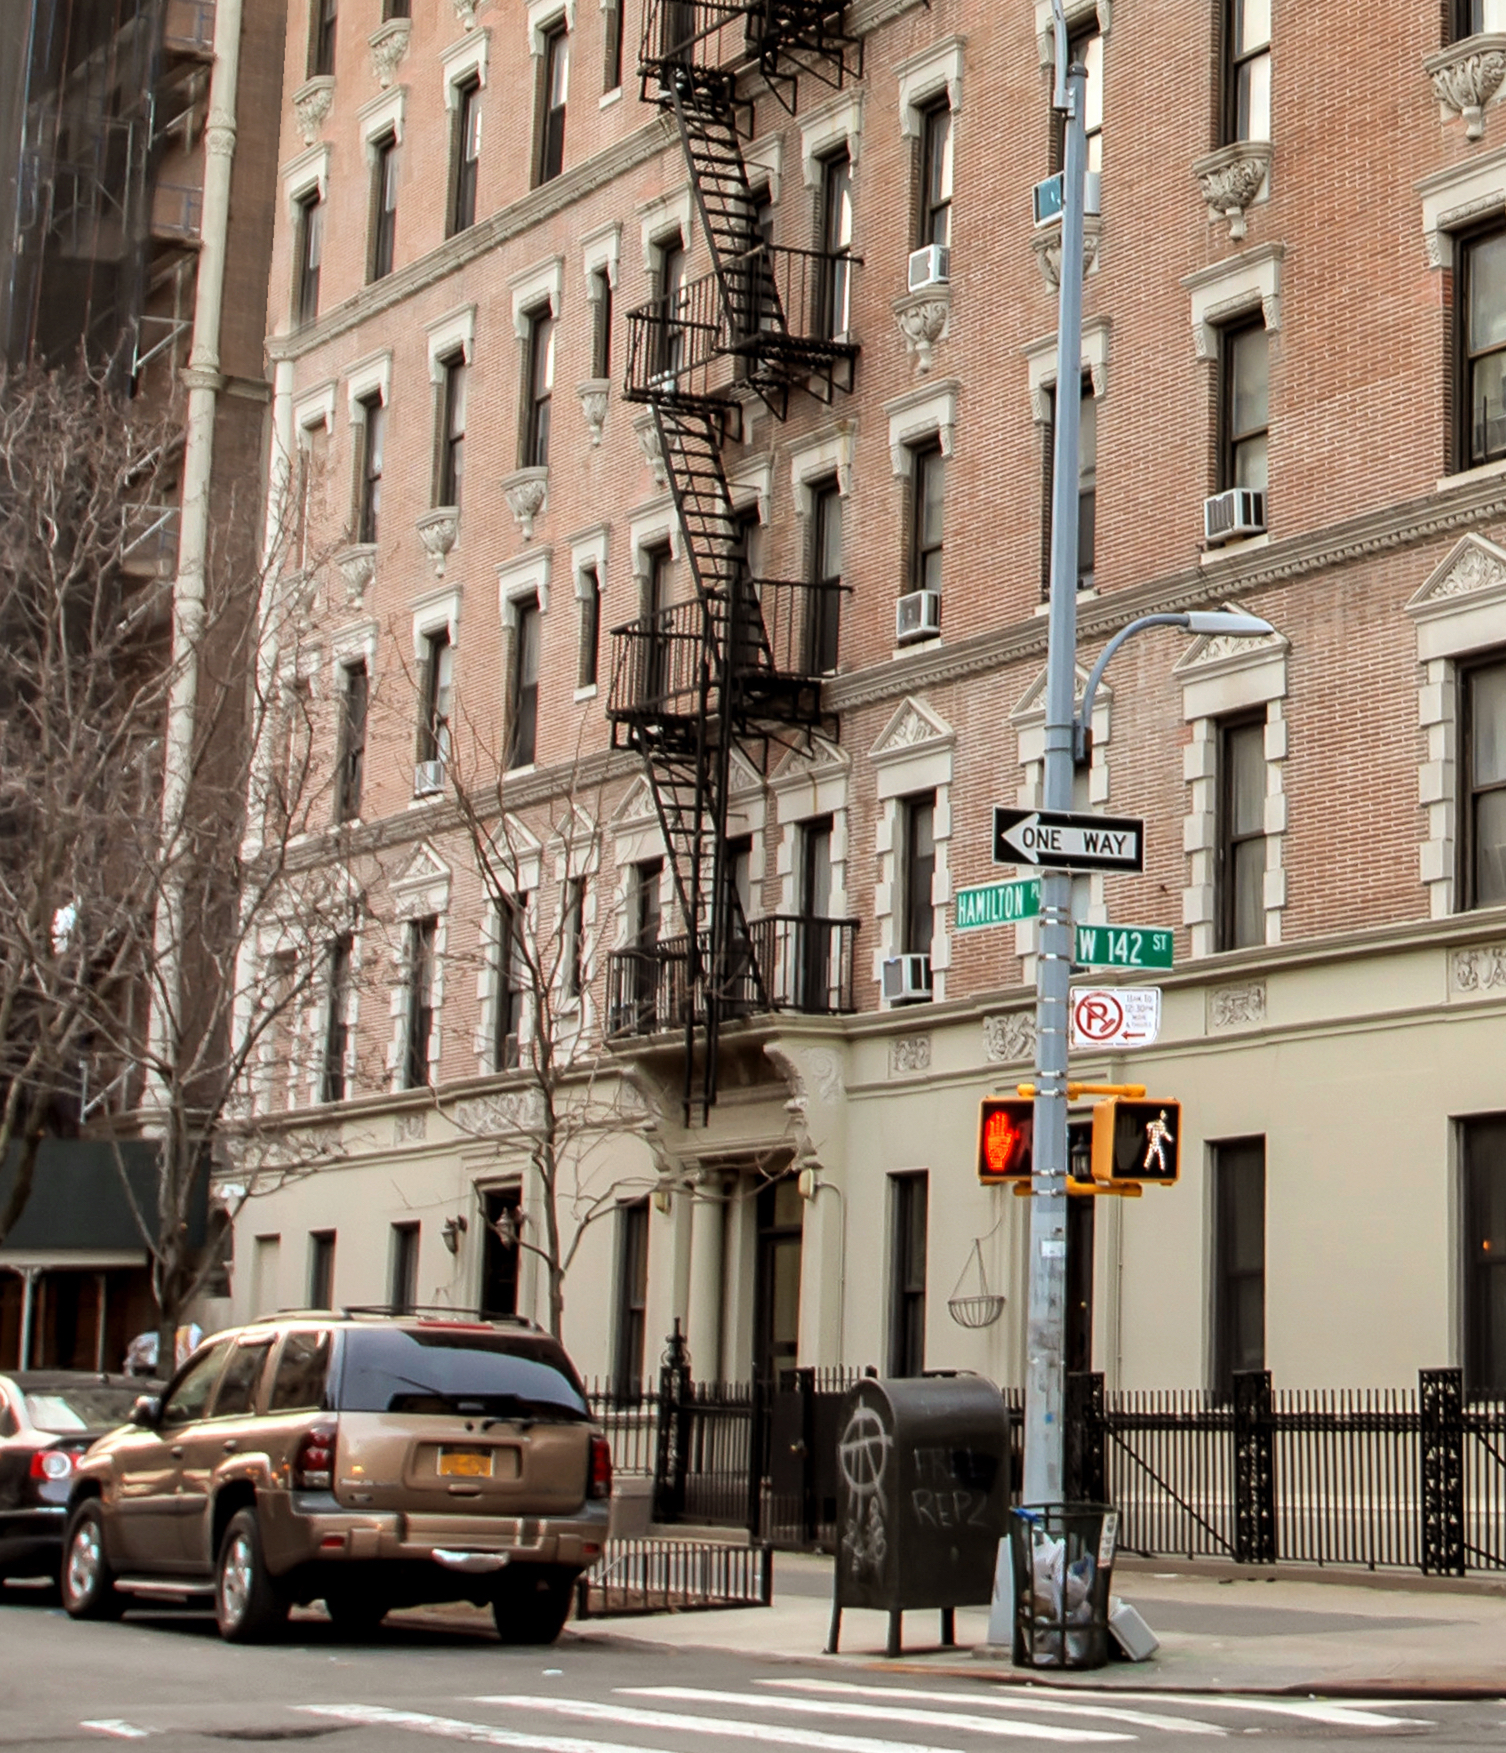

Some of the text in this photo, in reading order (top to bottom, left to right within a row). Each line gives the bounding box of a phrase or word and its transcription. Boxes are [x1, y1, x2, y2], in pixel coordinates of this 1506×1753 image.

[1022, 826, 1127, 855] ONE WAY
[958, 884, 1024, 925] HAMILTON
[1079, 929, 1167, 964] W 142 ST
